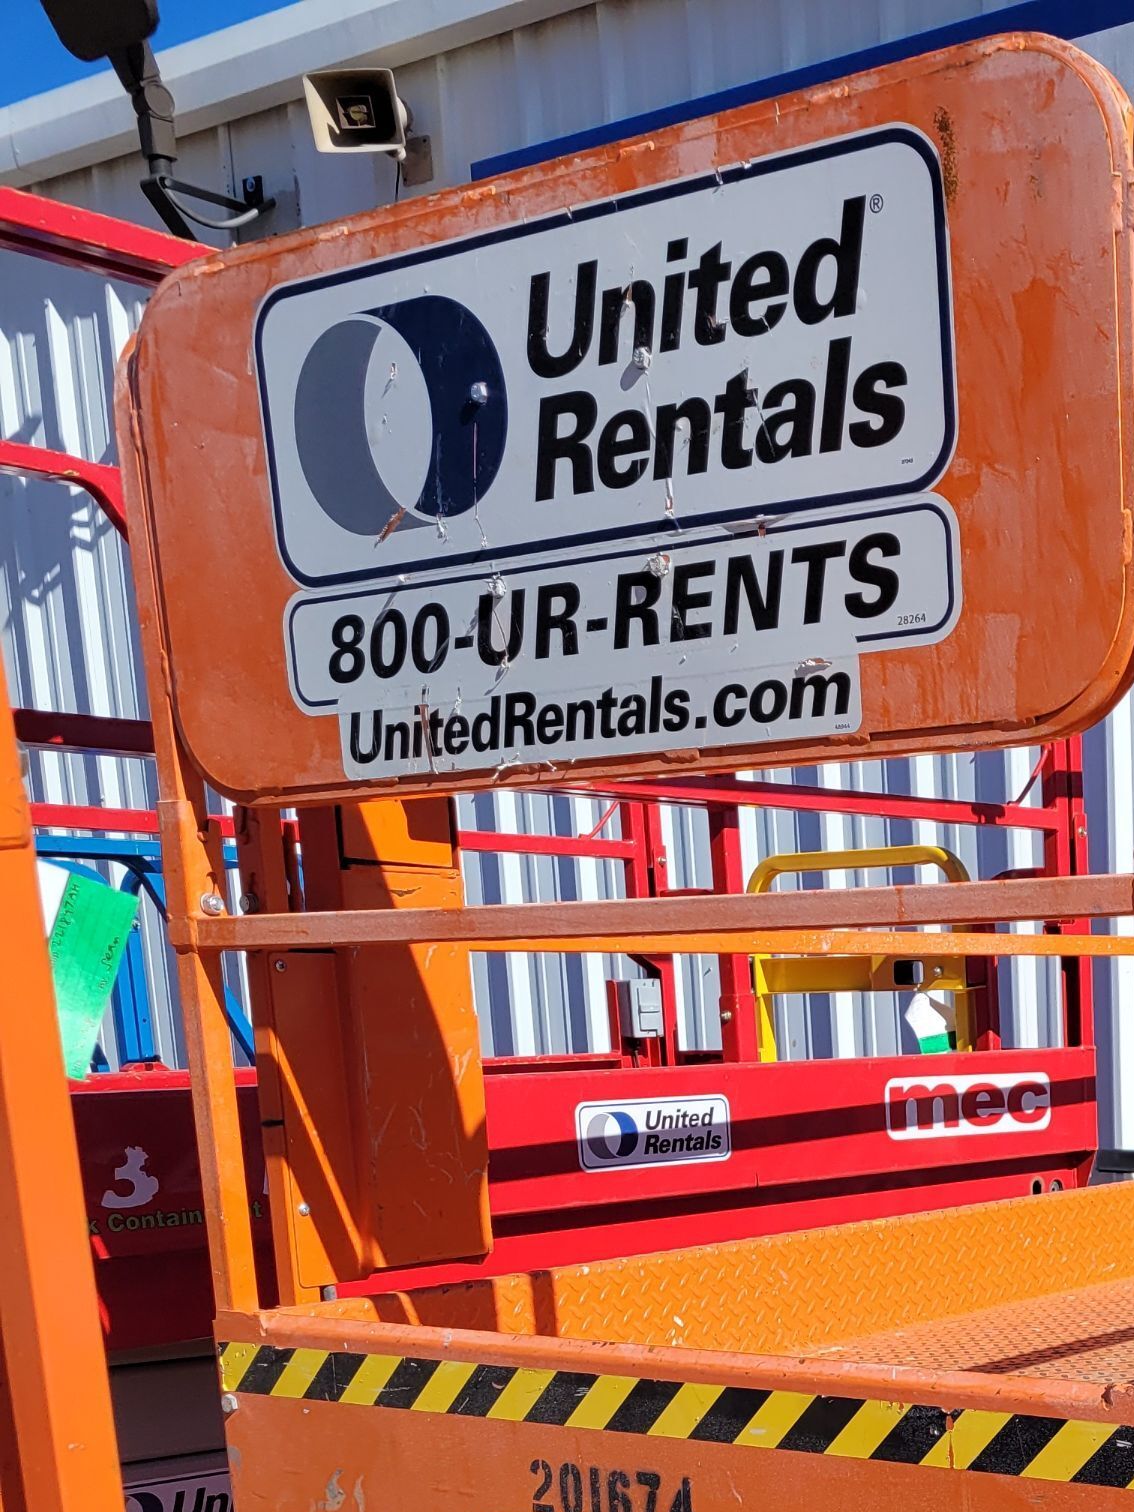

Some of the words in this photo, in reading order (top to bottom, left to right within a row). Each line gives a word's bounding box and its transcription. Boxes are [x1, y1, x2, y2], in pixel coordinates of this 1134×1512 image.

[527, 195, 866, 379] United
[535, 336, 908, 501] Rentals
[328, 532, 901, 684] 800-UR-RENTS
[897, 613, 926, 626] 28264
[349, 671, 852, 764] UnitedRentals.com
[645, 1107, 714, 1130] United
[889, 1080, 1048, 1131] mec
[644, 1130, 722, 1155] Rentals
